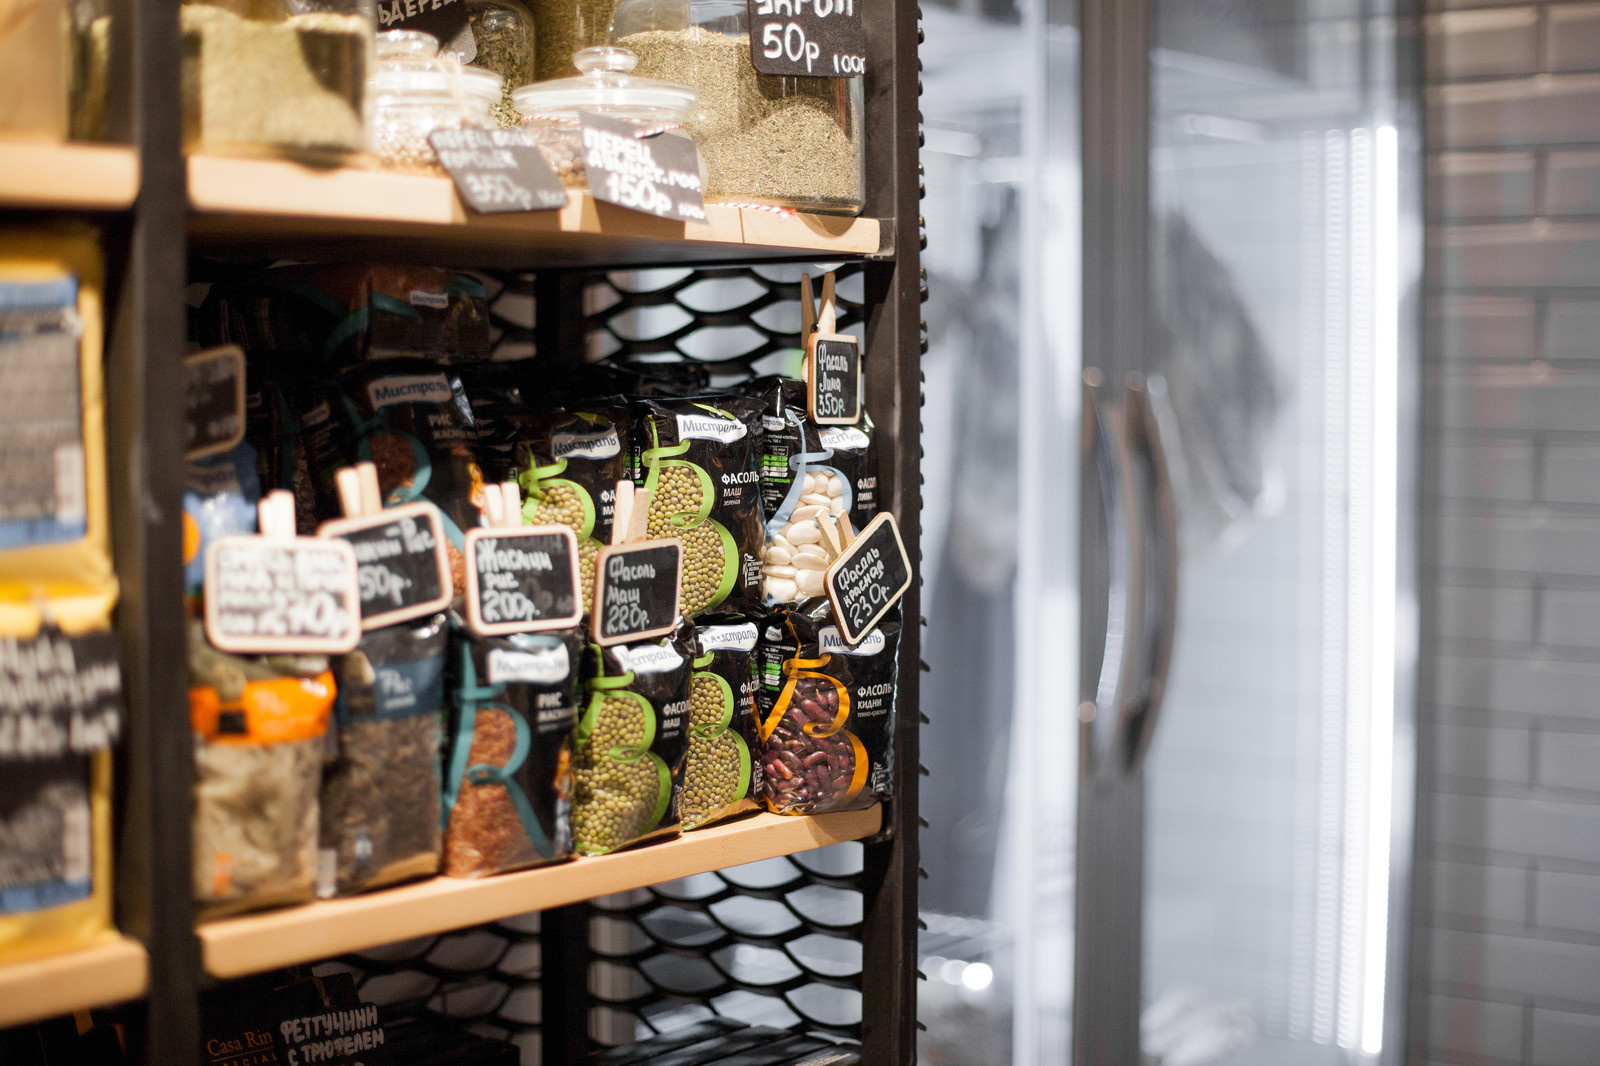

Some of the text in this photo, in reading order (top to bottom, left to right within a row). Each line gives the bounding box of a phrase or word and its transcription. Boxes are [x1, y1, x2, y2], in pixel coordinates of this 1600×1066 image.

[374, 381, 449, 401] Мистраль
[554, 435, 617, 456] Мистраль
[721, 471, 760, 485] ФАСОЛЬ
[723, 487, 743, 498] МАШ
[603, 505, 616, 517] МА
[610, 555, 656, 584] Фасоль
[606, 585, 640, 606] Маш
[857, 682, 893, 698] ФАСОЛЬ
[857, 698, 882, 710] КИДНИ
[207, 1029, 274, 1056] Casa Rin
